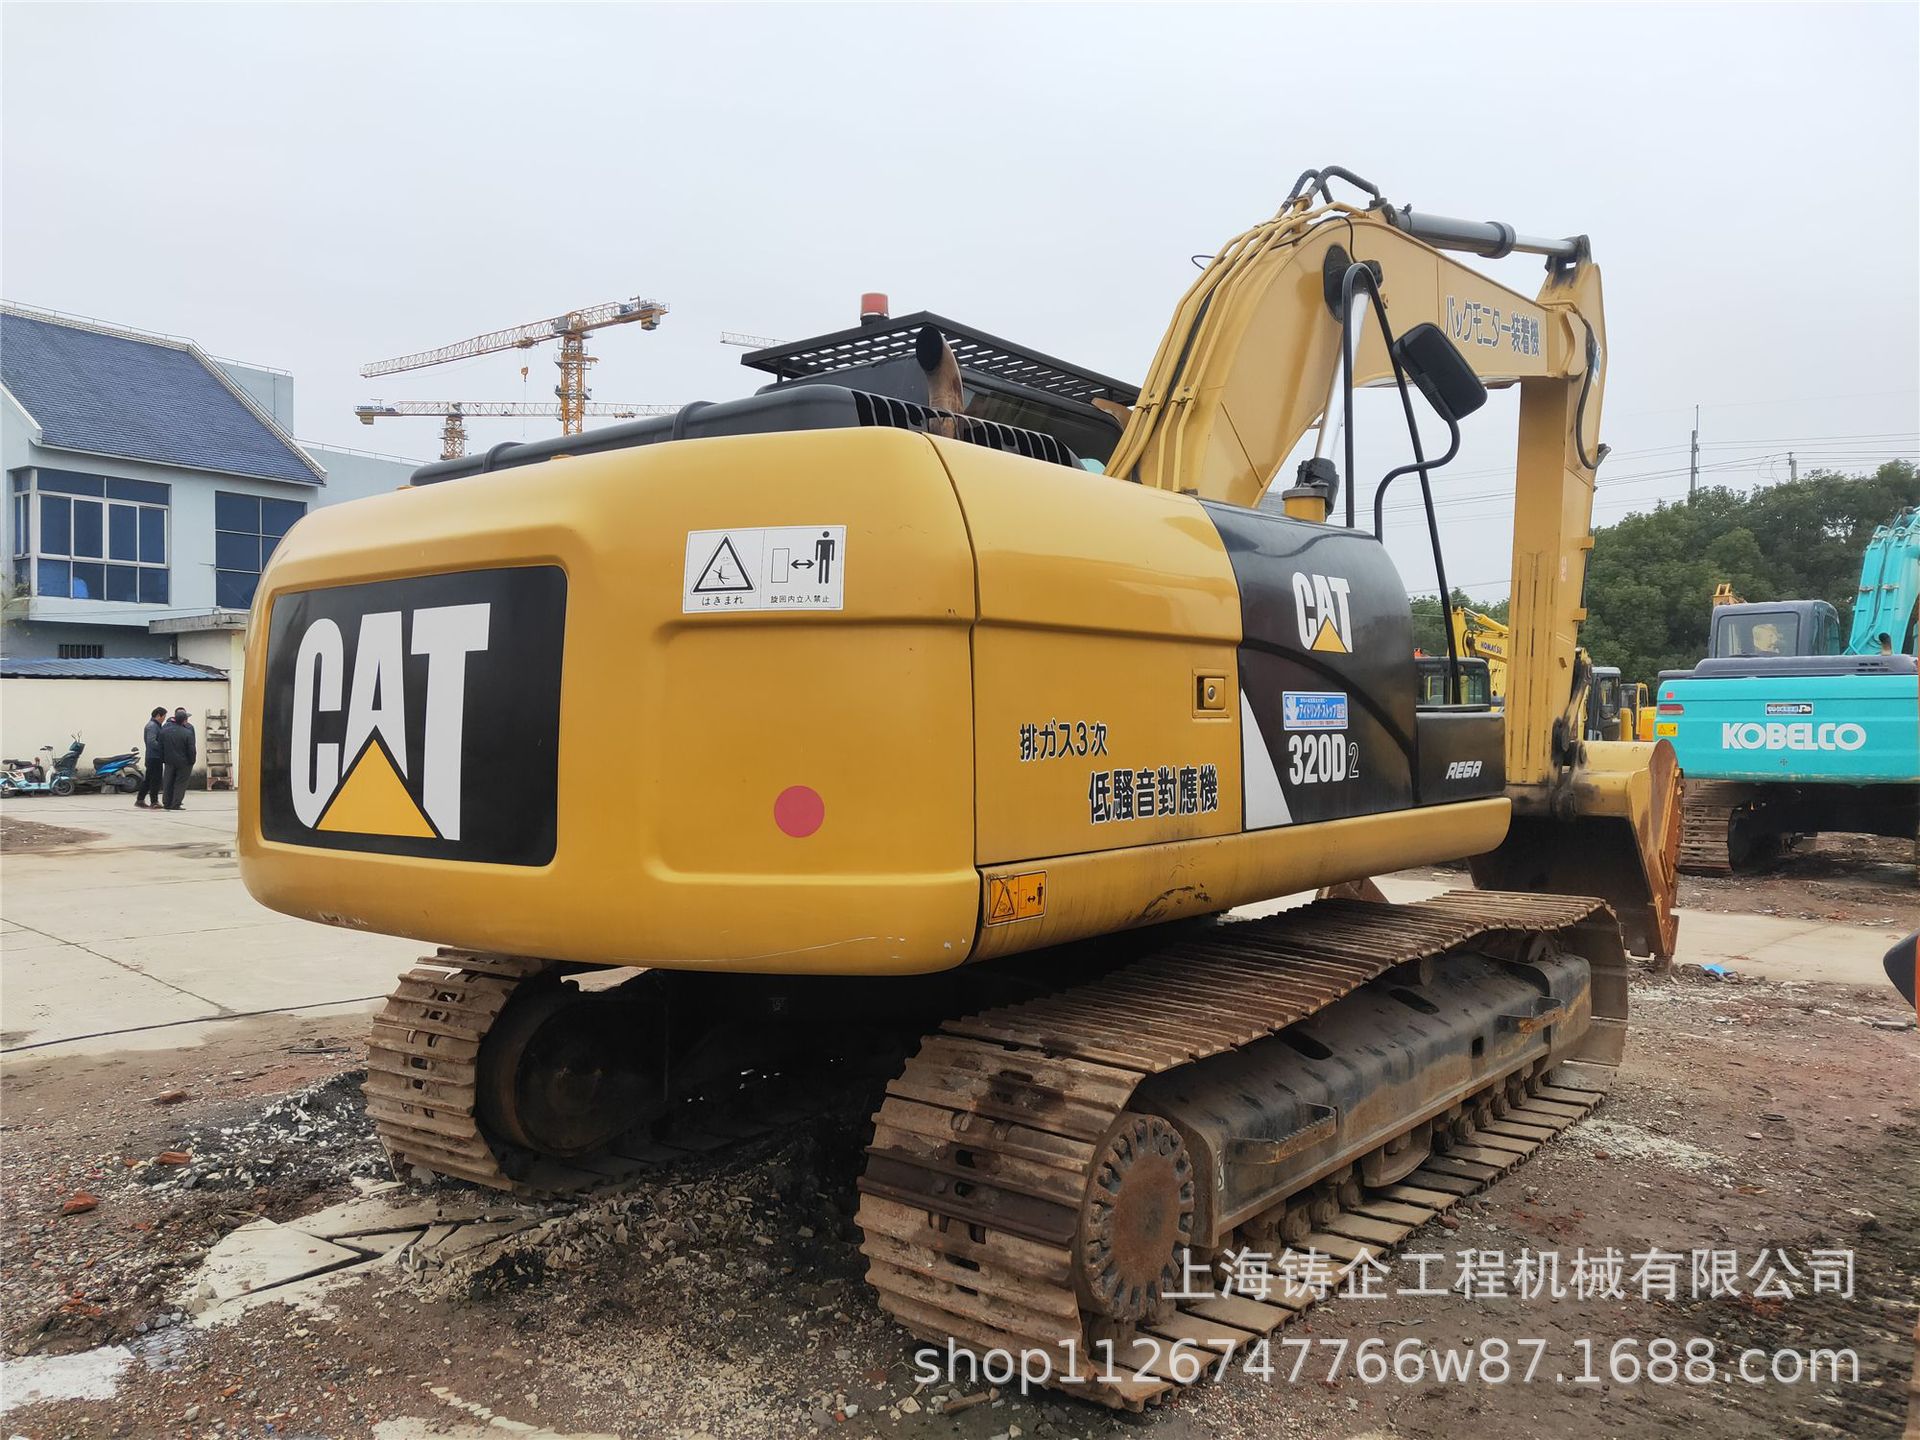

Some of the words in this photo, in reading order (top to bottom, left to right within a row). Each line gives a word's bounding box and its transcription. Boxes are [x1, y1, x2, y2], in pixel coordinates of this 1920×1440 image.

[1292, 571, 1353, 653] CAT
[290, 602, 491, 841] CAT
[1019, 717, 1108, 761] 排ガス3次
[1722, 722, 1867, 751] KOBELCO
